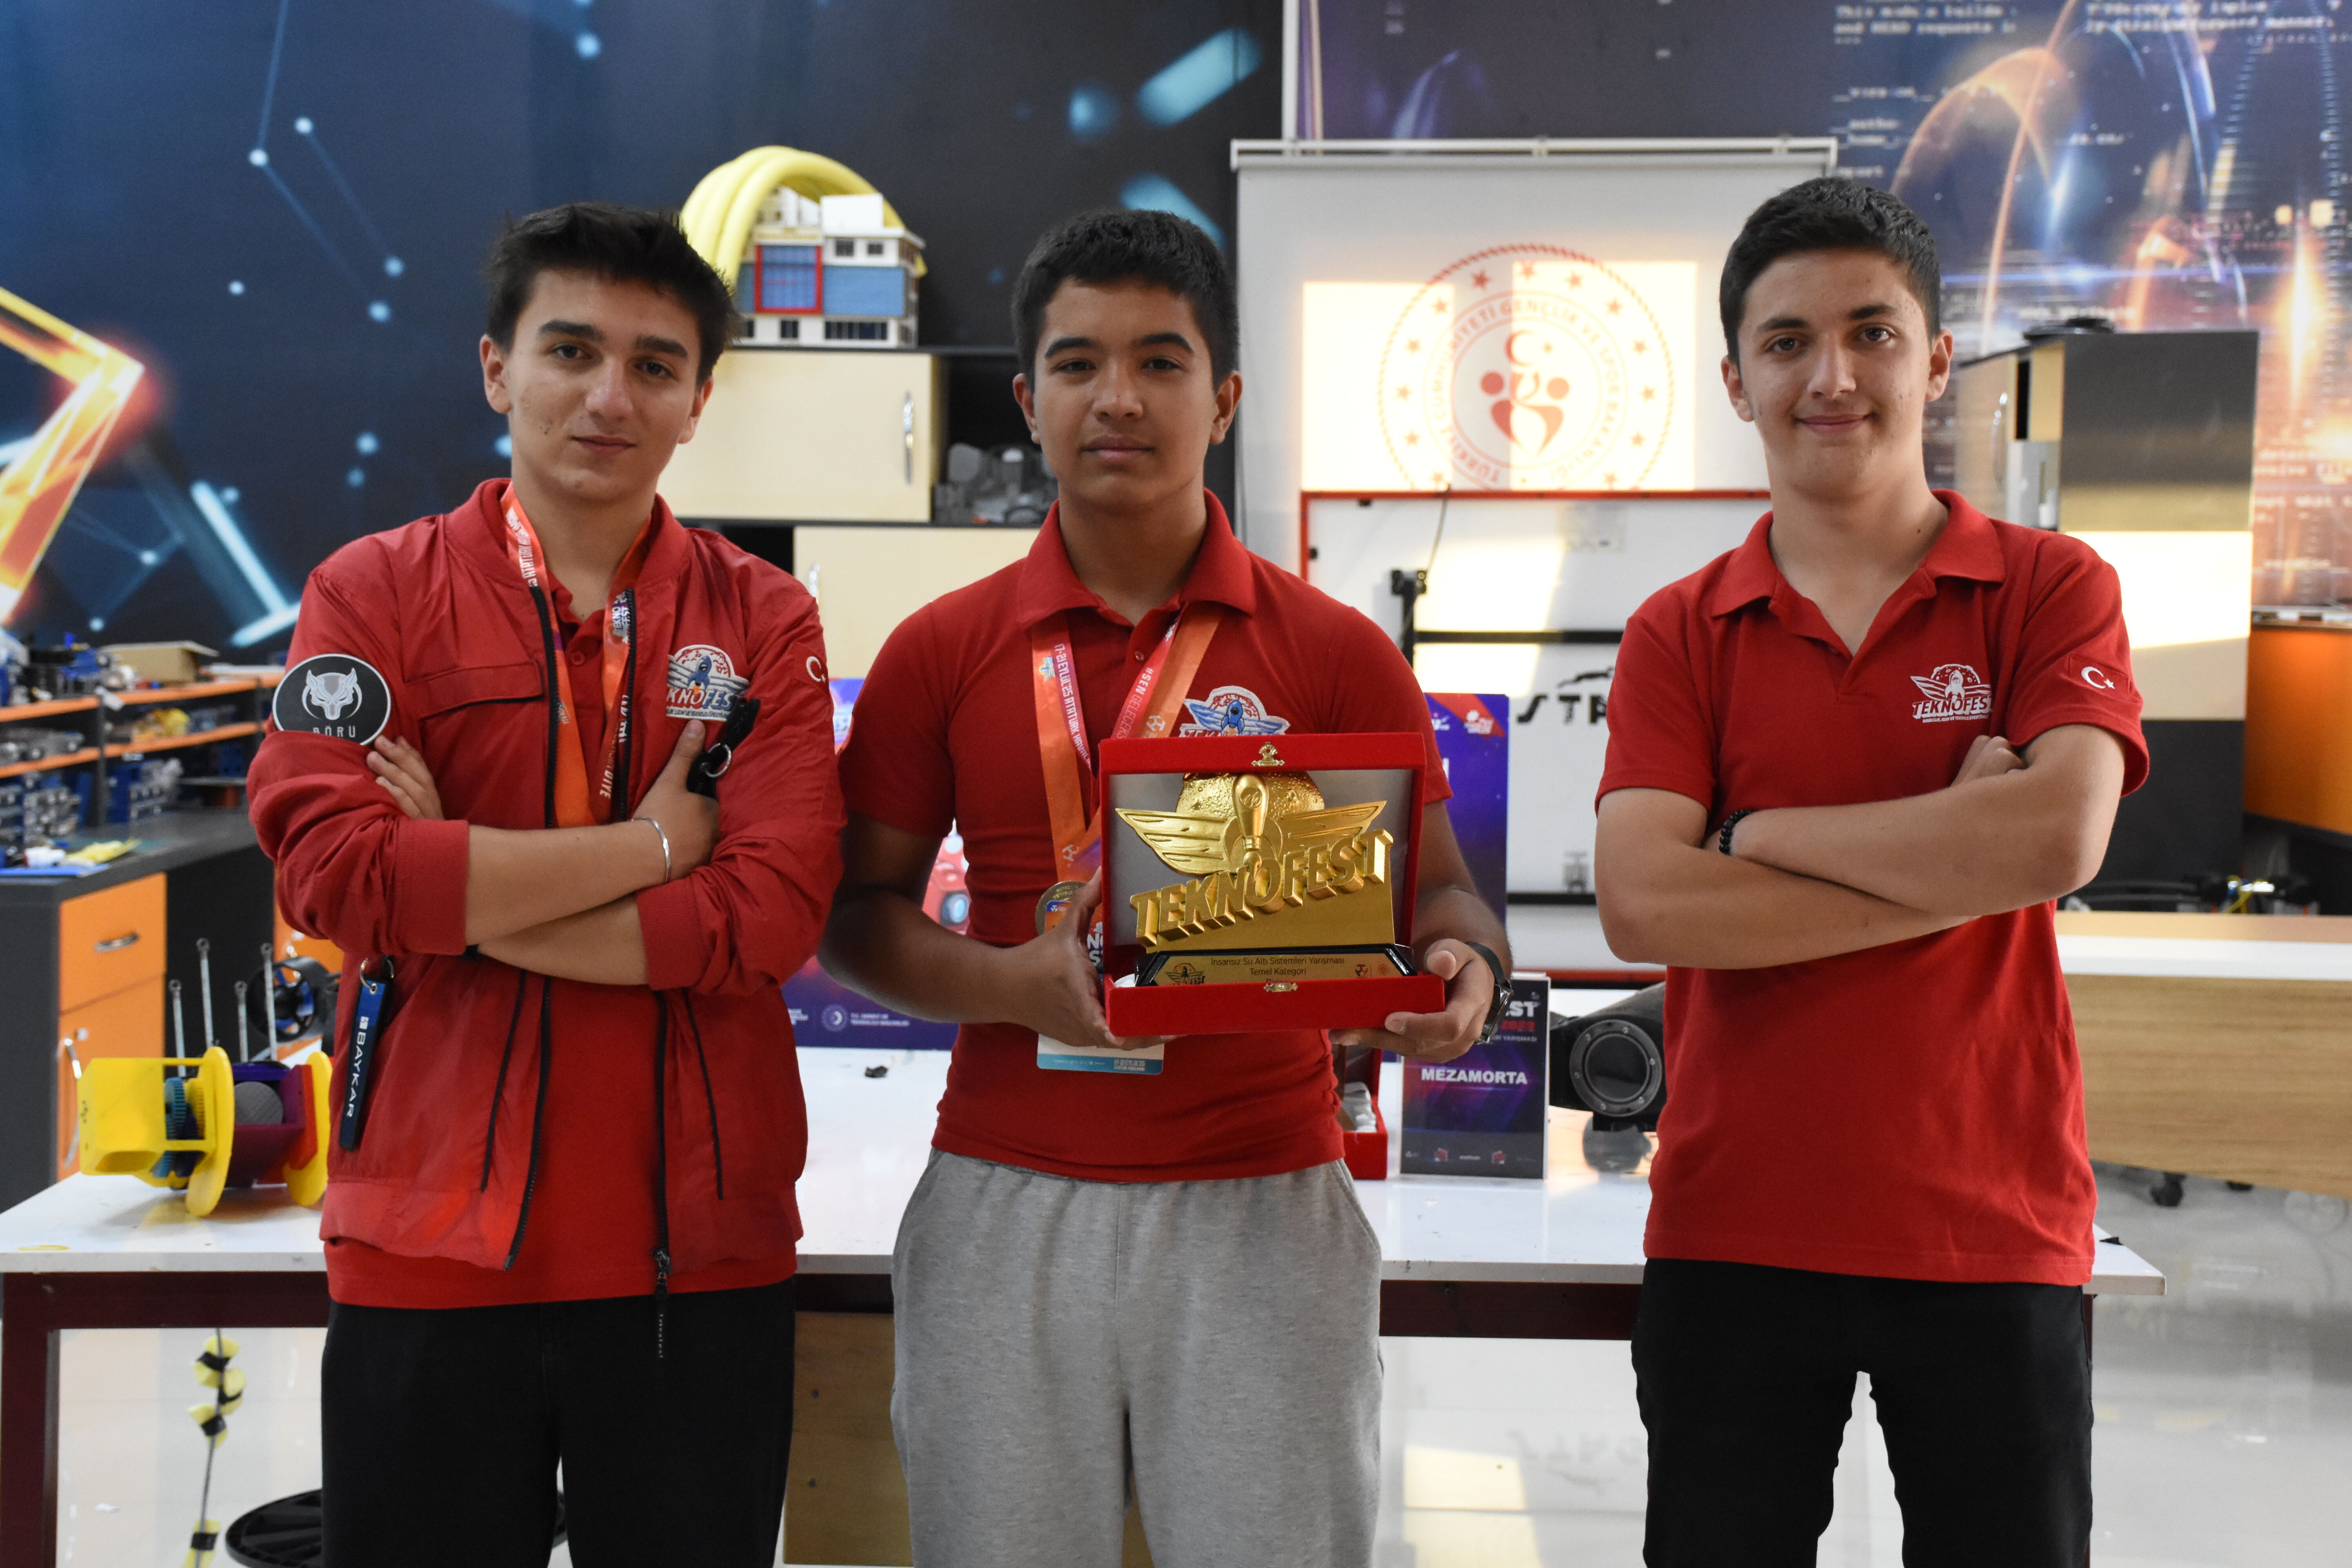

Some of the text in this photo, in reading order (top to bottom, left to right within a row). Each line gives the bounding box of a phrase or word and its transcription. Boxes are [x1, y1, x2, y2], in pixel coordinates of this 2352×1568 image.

[1135, 667, 1154, 695] #SEN
[1064, 696, 1080, 735] ATATÜRK
[1130, 829, 1394, 947] TEKNOFEST
[1274, 968, 1307, 976] Kategori
[347, 1031, 366, 1118] BAYKAR
[1421, 1068, 1528, 1085] MEZAMORTA
